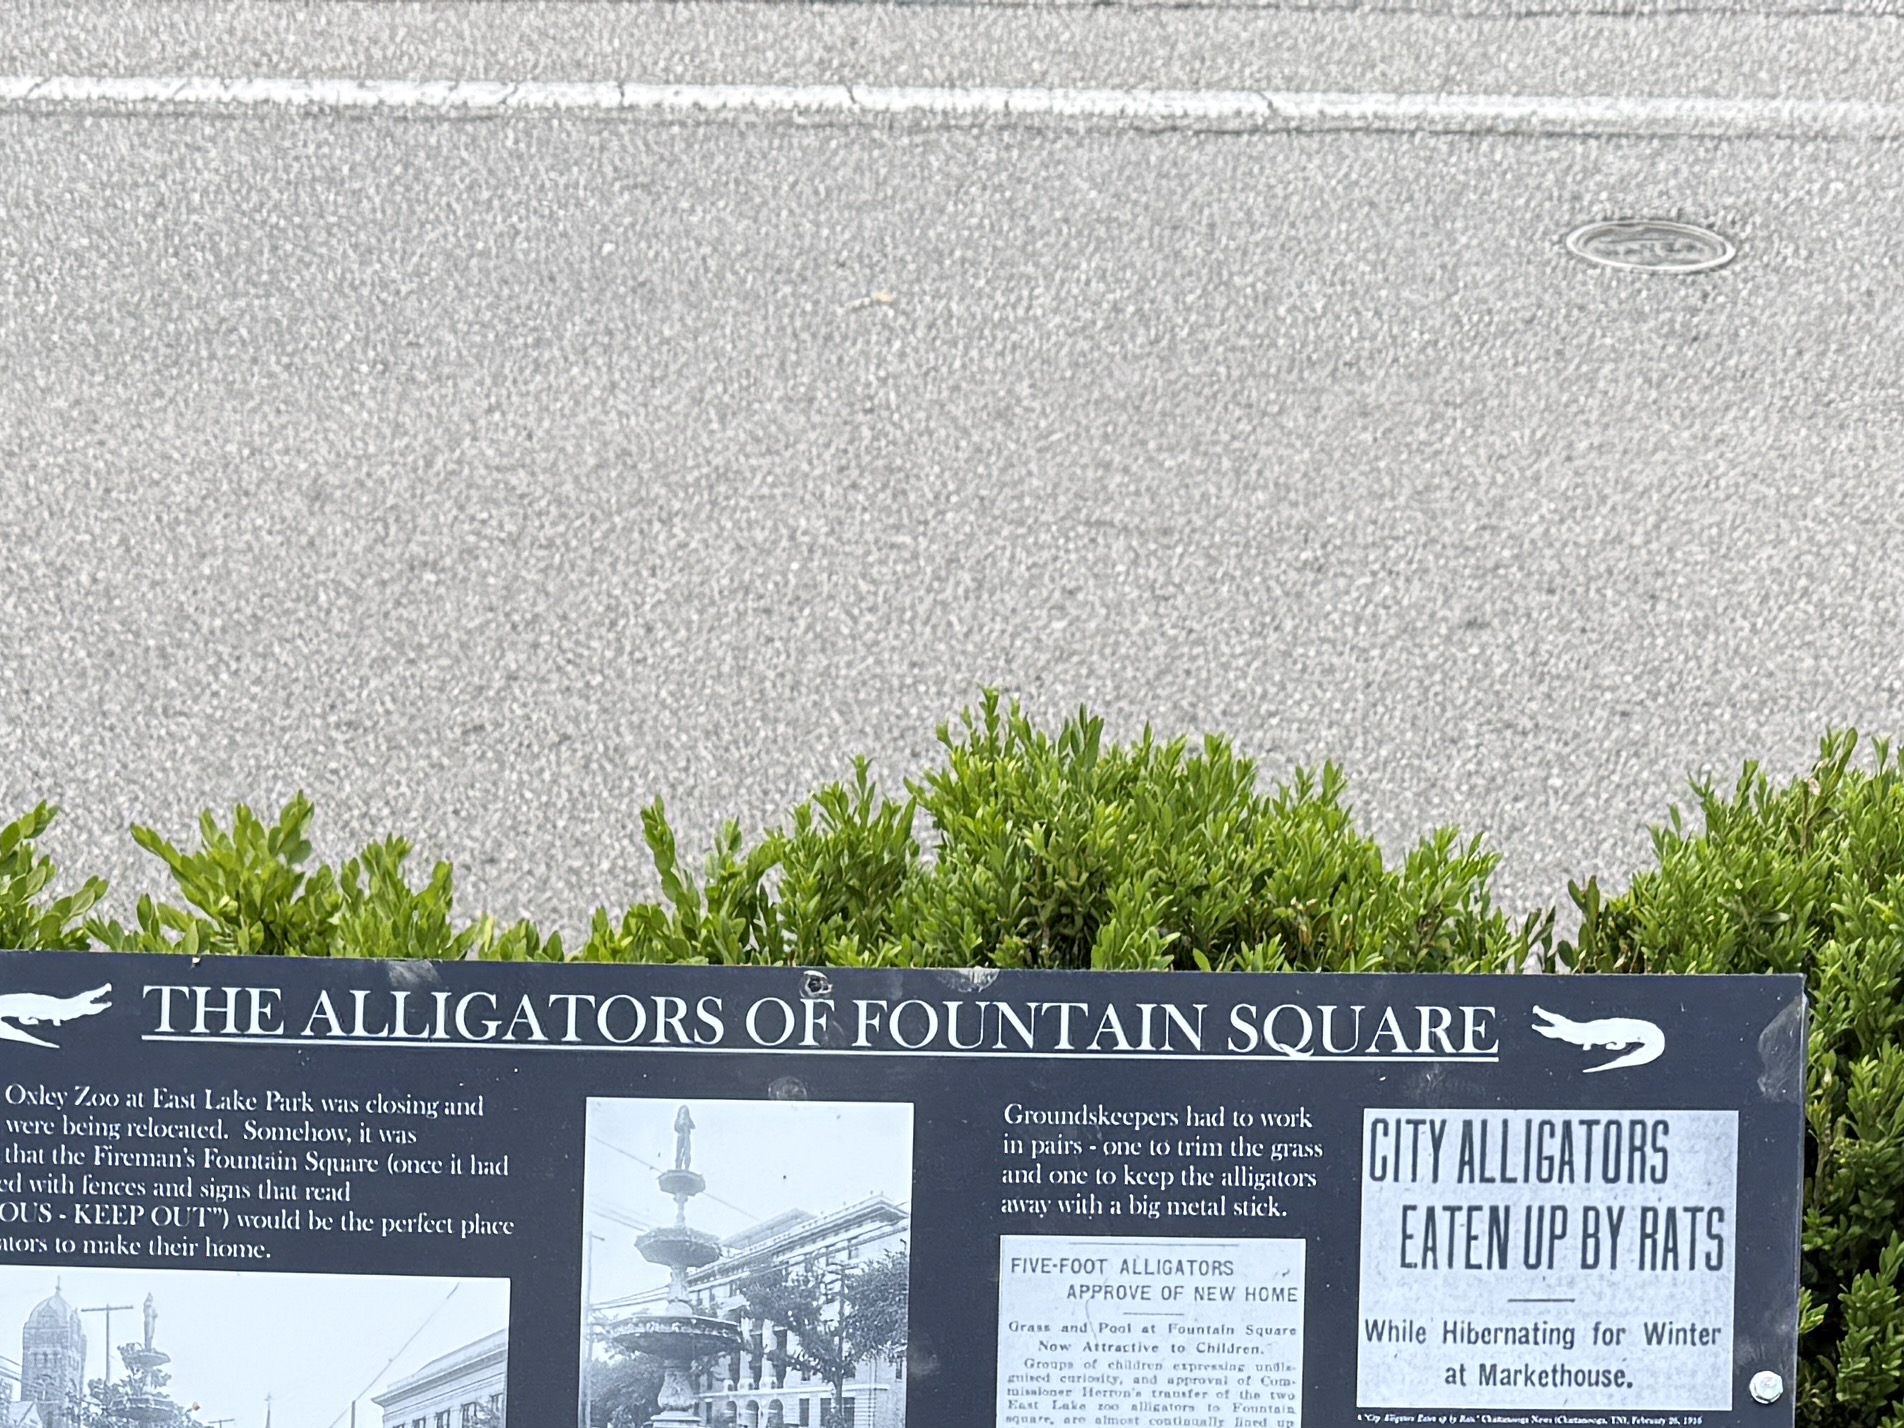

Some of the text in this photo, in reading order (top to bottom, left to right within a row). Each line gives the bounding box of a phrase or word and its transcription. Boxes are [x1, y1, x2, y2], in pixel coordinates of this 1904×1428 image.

[143, 985, 1500, 1059] THE ALLIGATORS OF FOUNTAIN SQUARE
[5, 1084, 68, 1110] Oxley
[75, 1086, 119, 1106] Zoo
[126, 1092, 143, 1108] at
[154, 1088, 195, 1109] East
[205, 1089, 257, 1110] Lake
[266, 1090, 314, 1112] Park
[321, 1099, 359, 1113] was
[366, 1093, 439, 1119] closing
[445, 1095, 483, 1116] and
[1004, 1104, 1312, 1131] Groundskeepers had to work
[6, 1143, 44, 1164] that
[53, 1144, 85, 1165] the
[94, 1145, 195, 1168] Fireman's
[204, 1148, 297, 1171] Fountain
[305, 1151, 378, 1176] Square
[388, 1153, 442, 1174] (once
[451, 1154, 462, 1175] it
[471, 1154, 508, 1176] had
[1004, 1133, 1023, 1154] in
[1032, 1134, 1082, 1159] pairs
[1103, 1142, 1141, 1155] one
[1150, 1140, 1170, 1156] to
[1178, 1135, 1222, 1156] trim
[1231, 1136, 1264, 1157] the
[1271, 1143, 1323, 1161] grass
[1369, 1118, 1669, 1184] CITY ALLIGATORS
[1002, 1163, 1316, 1191] and one to keep the alligators
[1001, 1193, 1287, 1219] away with a big metal stick.
[75, 1204, 144, 1225] KEEP
[151, 1206, 229, 1229] OUT")
[237, 1209, 300, 1230] would
[309, 1209, 333, 1230] be
[341, 1210, 374, 1231] the
[382, 1212, 453, 1237] perfect
[462, 1213, 514, 1239] place
[1400, 1204, 1725, 1271] EATEN UP BY RATS
[1011, 1257, 1234, 1276] FIVE-FOOT ALLIGATORS
[1067, 1284, 1297, 1302] APPROVE OF NEW HOME
[1009, 1322, 1296, 1337] Grass and Pool at Fountain Square
[1365, 1319, 1721, 1350] While Hibernating for Winter
[1038, 1340, 1264, 1354] Now Attractive to Children.
[1445, 1363, 1633, 1389] at Markethouse.
